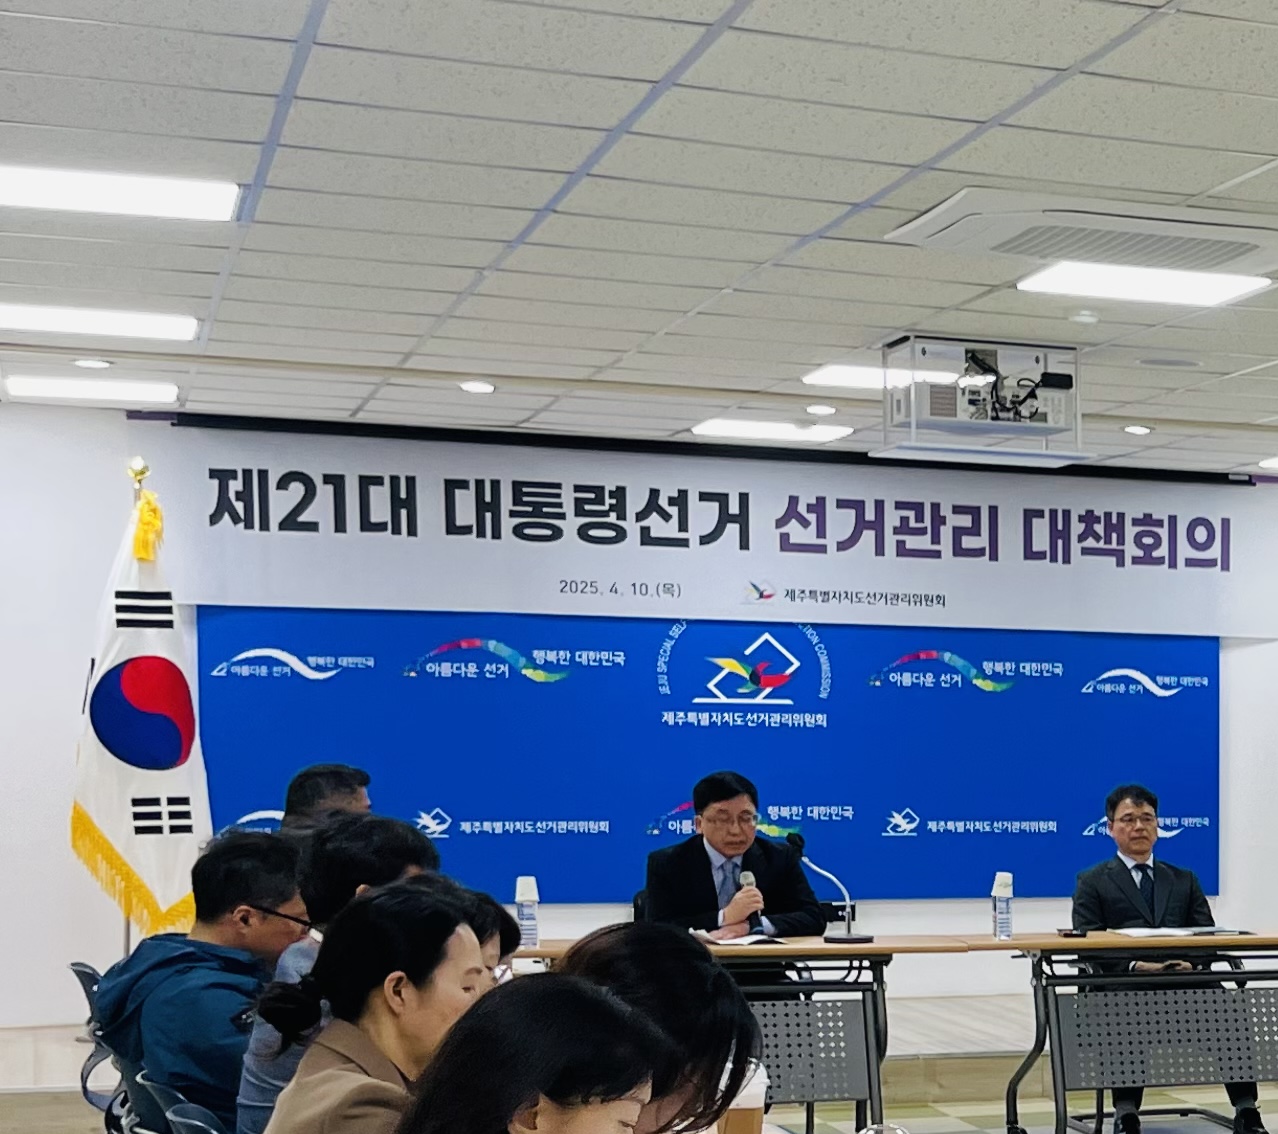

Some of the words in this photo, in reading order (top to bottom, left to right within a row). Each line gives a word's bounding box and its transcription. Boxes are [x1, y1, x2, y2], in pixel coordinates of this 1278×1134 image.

[208, 467, 419, 538] 제21대
[443, 477, 751, 552] 대통령선거
[774, 494, 1000, 562] 선거관리
[1022, 507, 1232, 573] 대책회의
[558, 579, 604, 596] 2025.
[783, 587, 947, 609] 제주특별자치도선거관리위원회
[532, 649, 571, 665] 행복한
[574, 650, 626, 667] 대한민국
[425, 661, 480, 679] 아름다운
[483, 662, 510, 679] 선거
[982, 661, 1016, 676] 행복한
[1019, 661, 1064, 677] 대한민국
[888, 671, 936, 688] 아름다운
[939, 672, 962, 689] 선거
[661, 710, 828, 729] 제주특별자치도선거관리위원회
[766, 804, 803, 821] 행복한
[806, 805, 855, 821] 대한민국
[459, 820, 610, 834] 제주특별자치도선거관리위원회
[926, 820, 1058, 833] 제주특별자치도선거관리위원회
